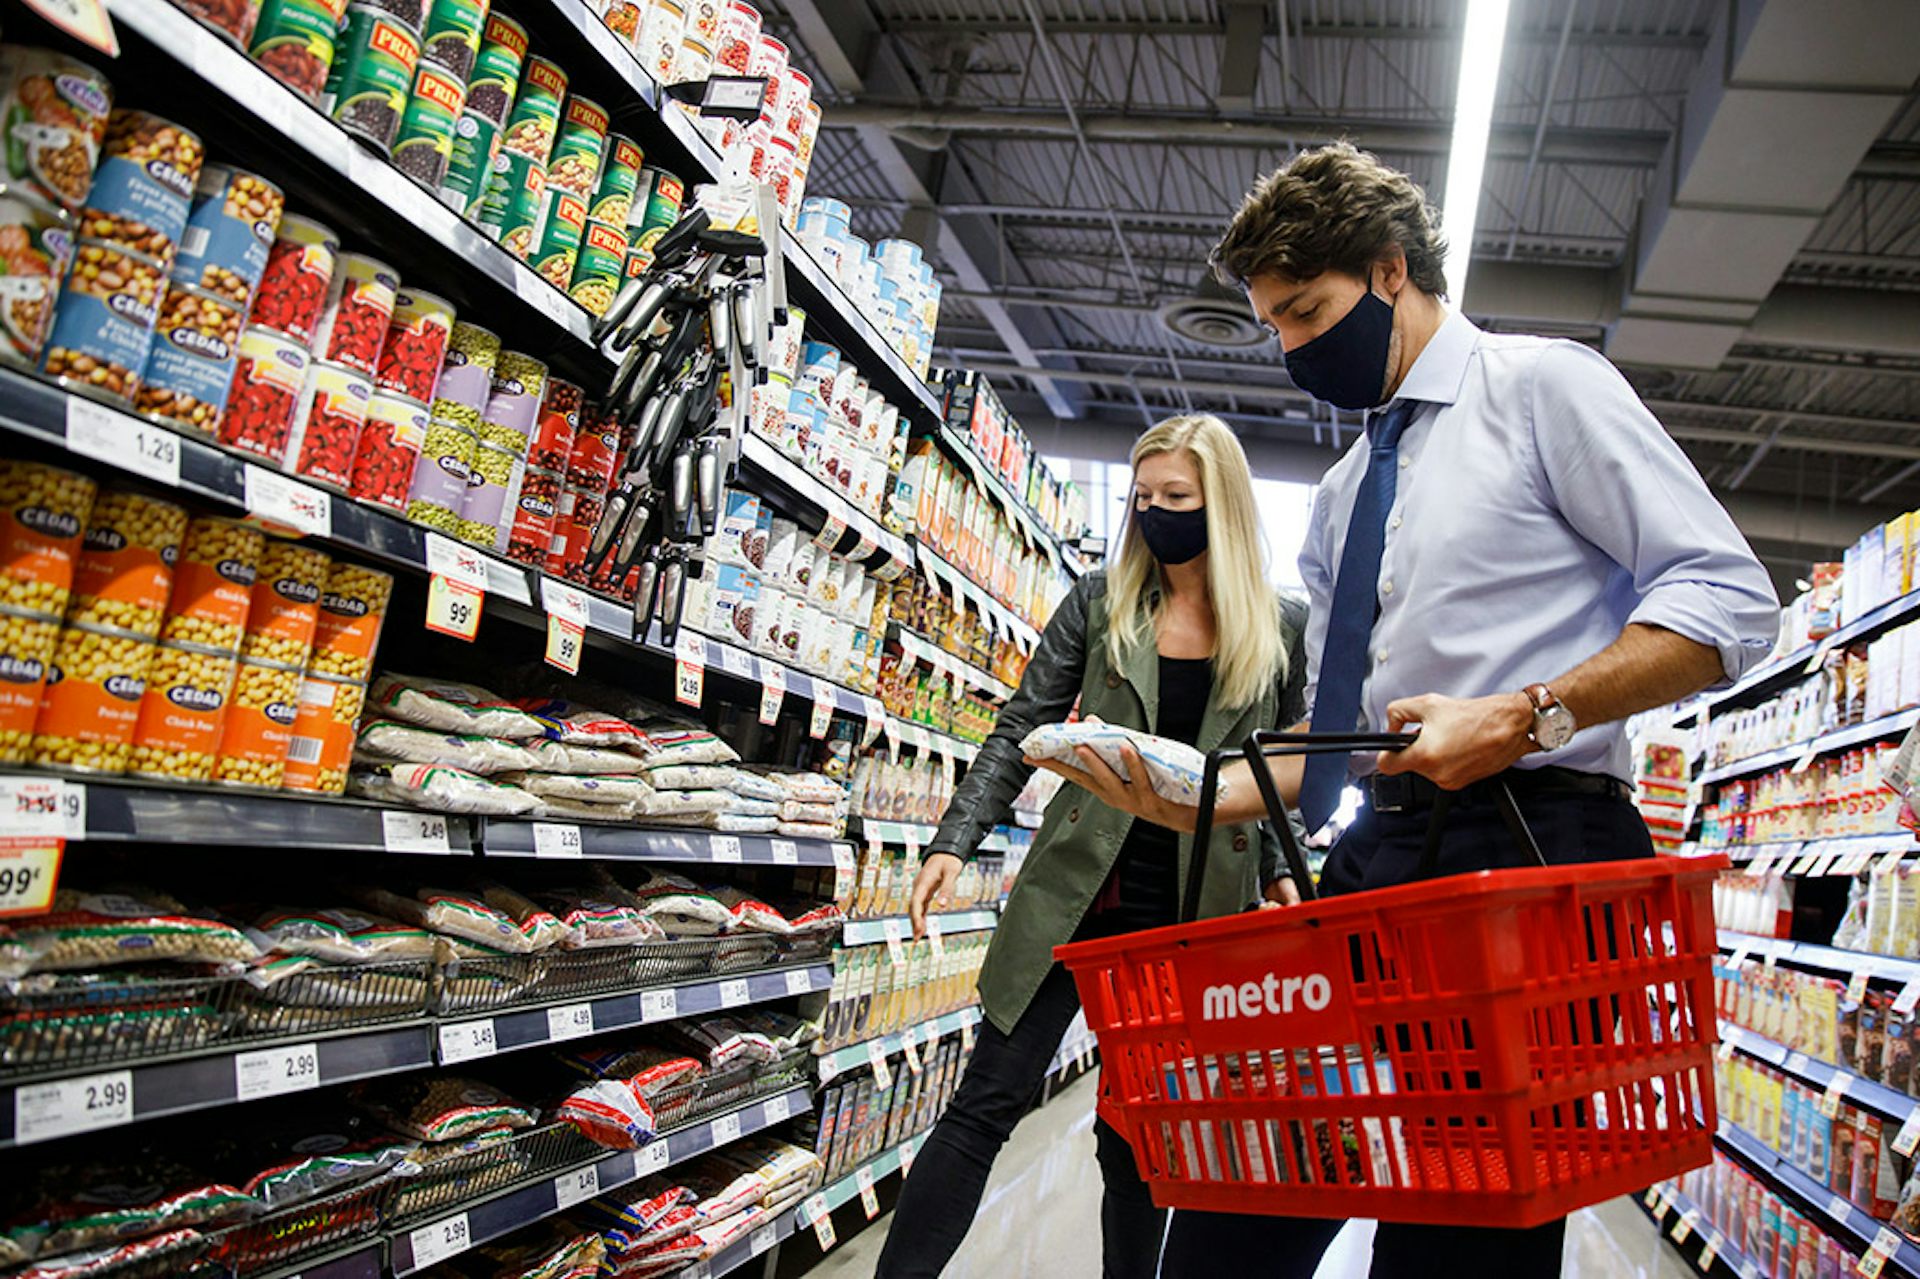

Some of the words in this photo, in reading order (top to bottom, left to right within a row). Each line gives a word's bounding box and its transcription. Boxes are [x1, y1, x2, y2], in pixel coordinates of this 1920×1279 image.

[173, 329, 229, 359] CEDAR
[136, 433, 175, 464] 1.29
[172, 687, 222, 708] CEDAR
[421, 820, 444, 840] 2.49
[562, 830, 579, 848] 2.29
[1202, 972, 1331, 1021] metro
[472, 1027, 493, 1047] 3.49
[286, 1056, 314, 1077] 2.99
[86, 1082, 127, 1110] 2.99
[579, 1170, 595, 1189] 2.49
[443, 1220, 466, 1244] 2.99
